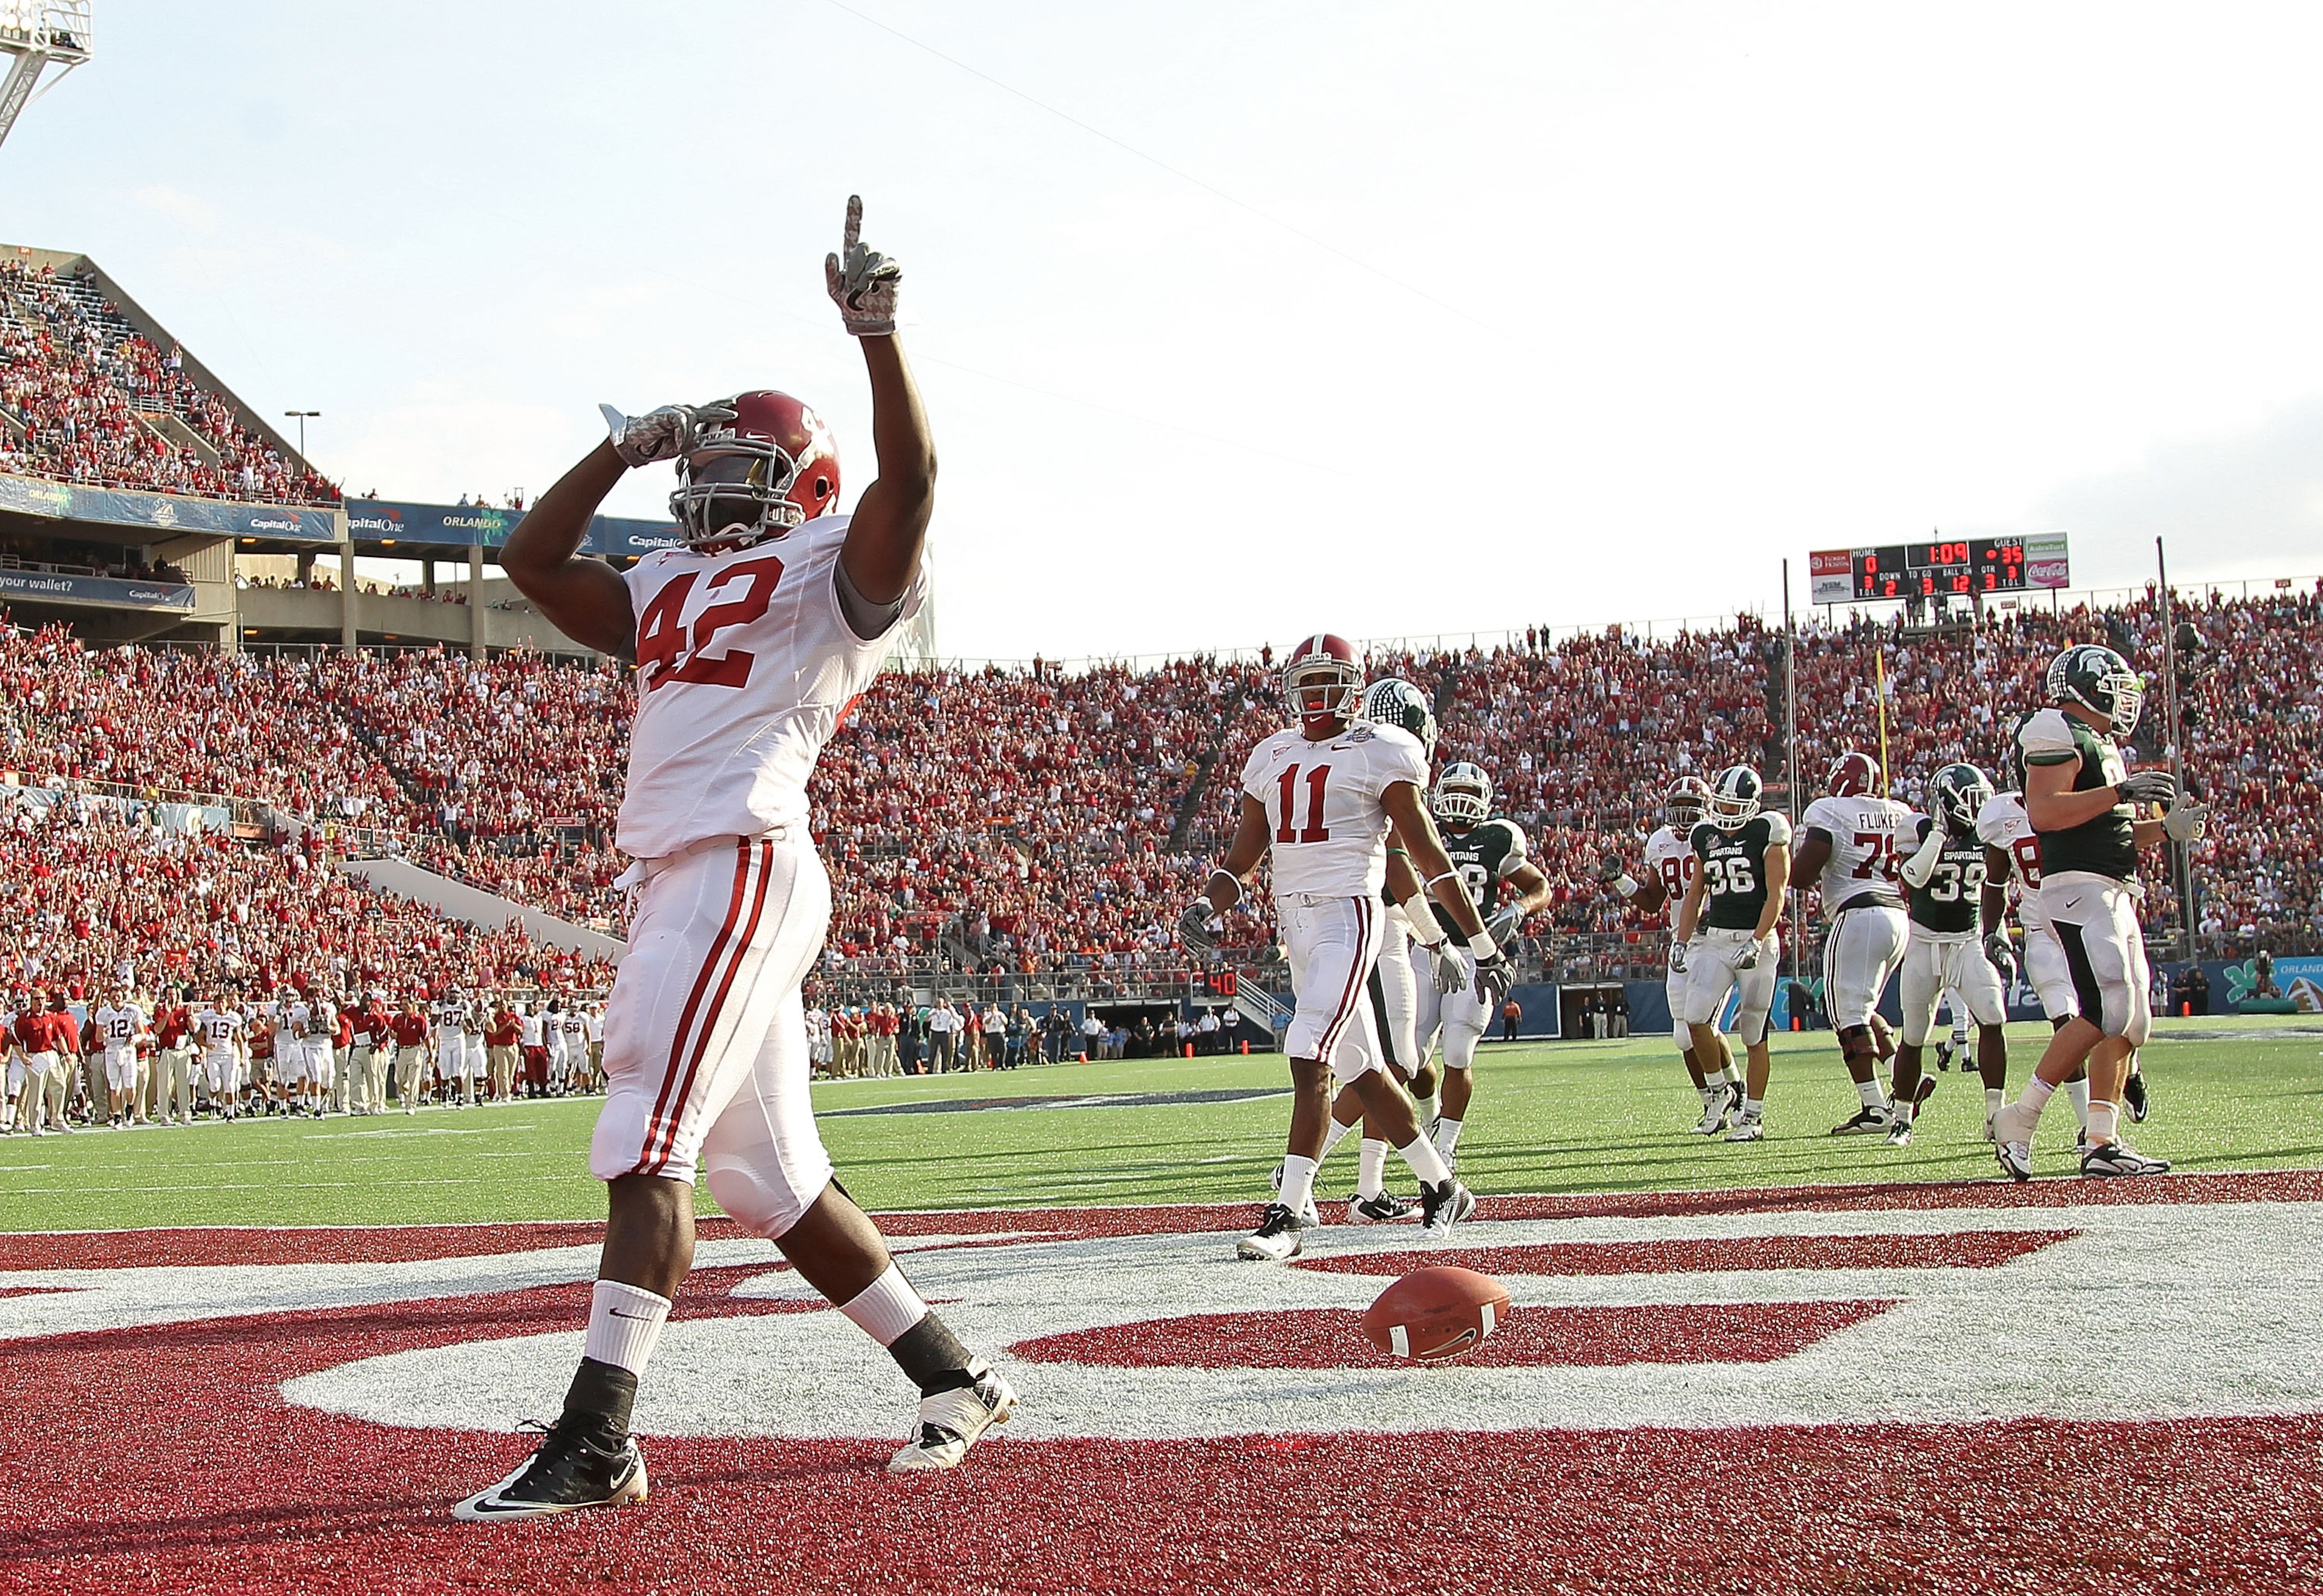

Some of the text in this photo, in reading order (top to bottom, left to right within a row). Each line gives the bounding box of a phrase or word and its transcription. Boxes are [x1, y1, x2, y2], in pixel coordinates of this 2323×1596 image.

[29, 489, 68, 503] ORLANDO
[348, 518, 404, 532] apitalOne
[443, 516, 502, 529] ORLANDO
[1994, 538, 2022, 547] GUEST
[1852, 549, 1877, 558] HOME
[1929, 542, 1967, 564] 1:09
[2001, 546, 2024, 564] 35
[1865, 556, 1878, 574] 0
[1942, 567, 1972, 576] BALL ON
[1981, 565, 1996, 573] QTR
[1879, 572, 1901, 581] DOWN
[1909, 570, 1918, 579] TO
[1985, 573, 1996, 590] 3
[0, 576, 73, 591] your wallet?
[1884, 580, 1897, 598] 2
[1922, 577, 1934, 594] 3
[1952, 575, 1970, 592] 12
[636, 556, 786, 693] 42
[1276, 763, 1331, 844] 11
[1449, 851, 1480, 862] RTANS
[1708, 847, 1743, 858] SPARTANS
[1944, 851, 1984, 861] SPARTANS
[1703, 856, 1756, 896] 36
[1930, 863, 1988, 905] 39
[2281, 964, 2323, 974] ORLAND
[1209, 972, 1235, 995] 40
[443, 1010, 463, 1026] 87
[109, 1020, 129, 1038] 12
[211, 1021, 230, 1039] 13
[565, 1021, 581, 1033] 58
